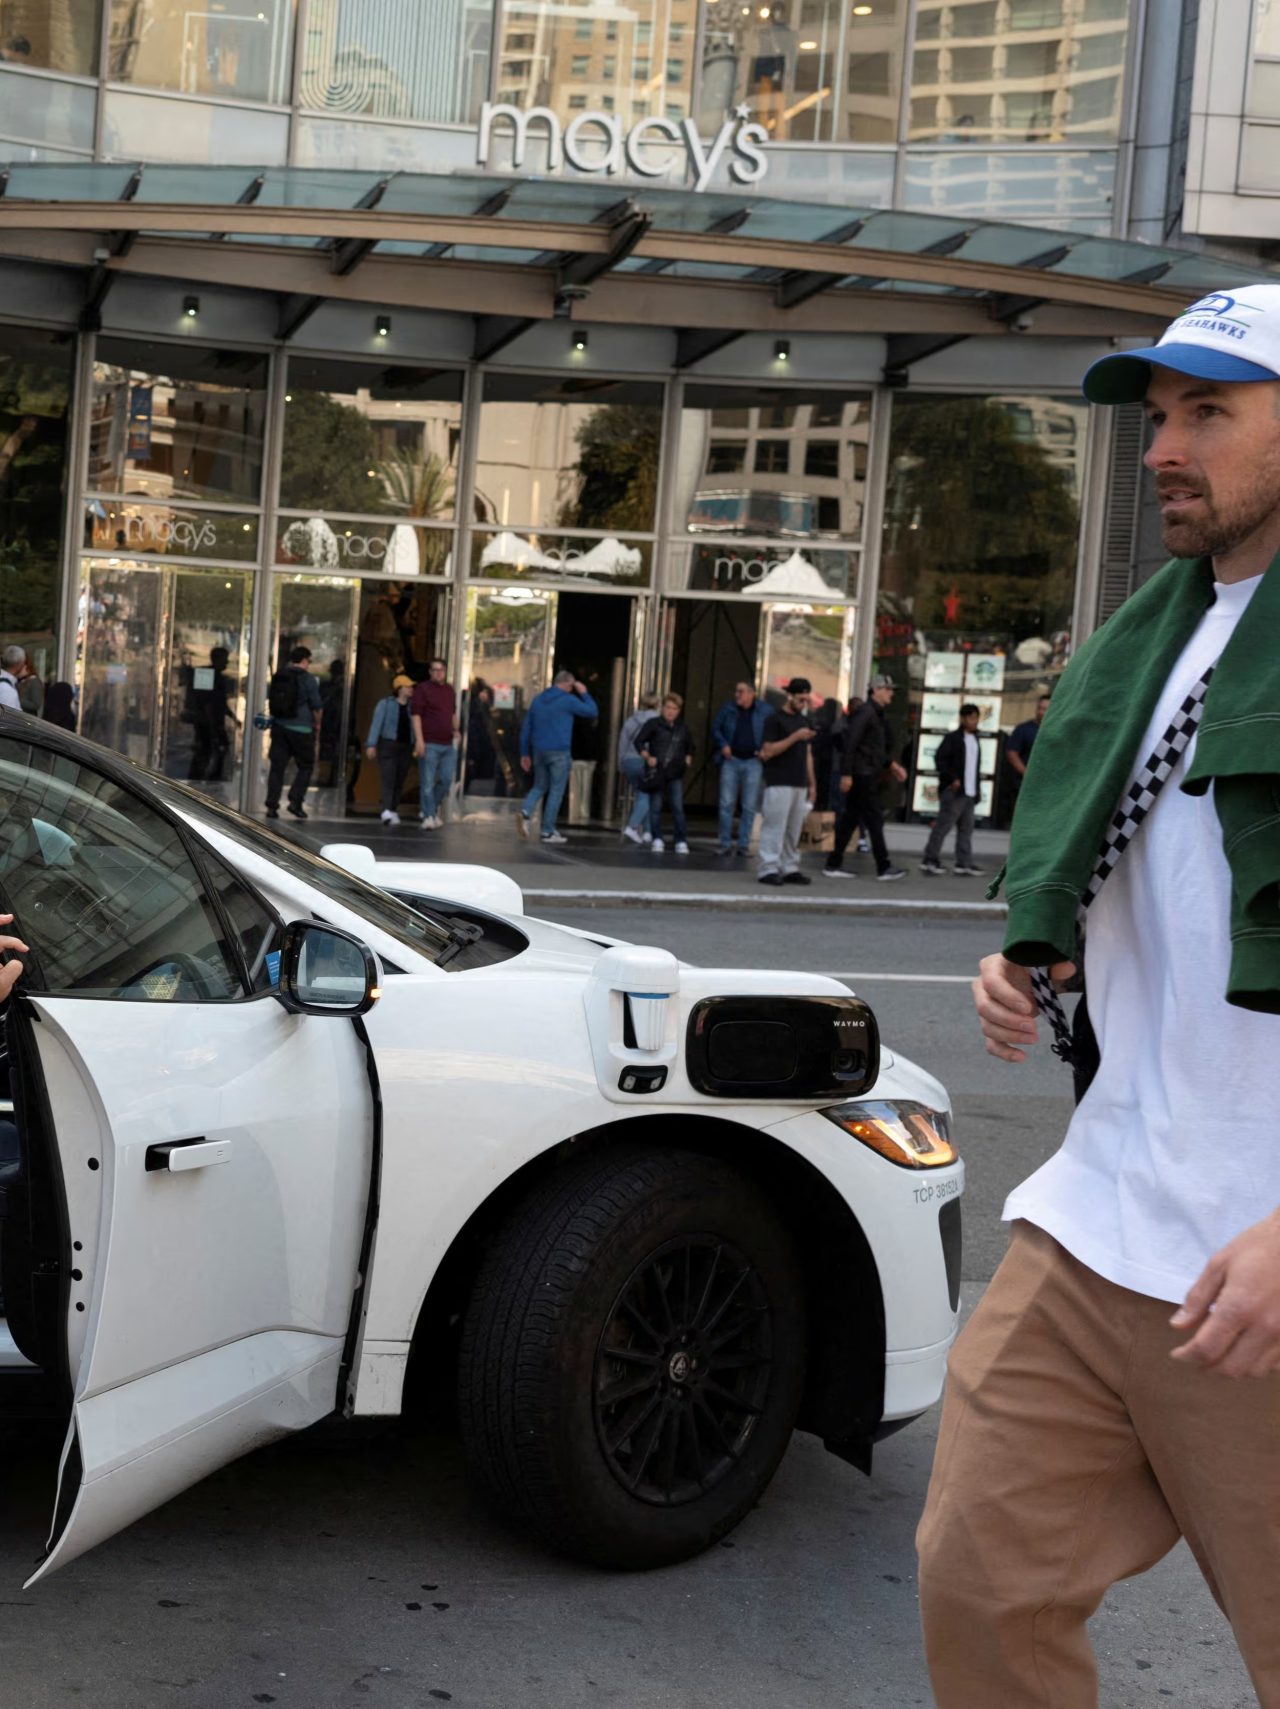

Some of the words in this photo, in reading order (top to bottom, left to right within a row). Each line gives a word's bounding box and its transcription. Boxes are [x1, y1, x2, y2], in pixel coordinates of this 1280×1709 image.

[477, 101, 769, 192] macy's
[124, 514, 217, 551] macy's
[913, 1186, 934, 1204] TCP
